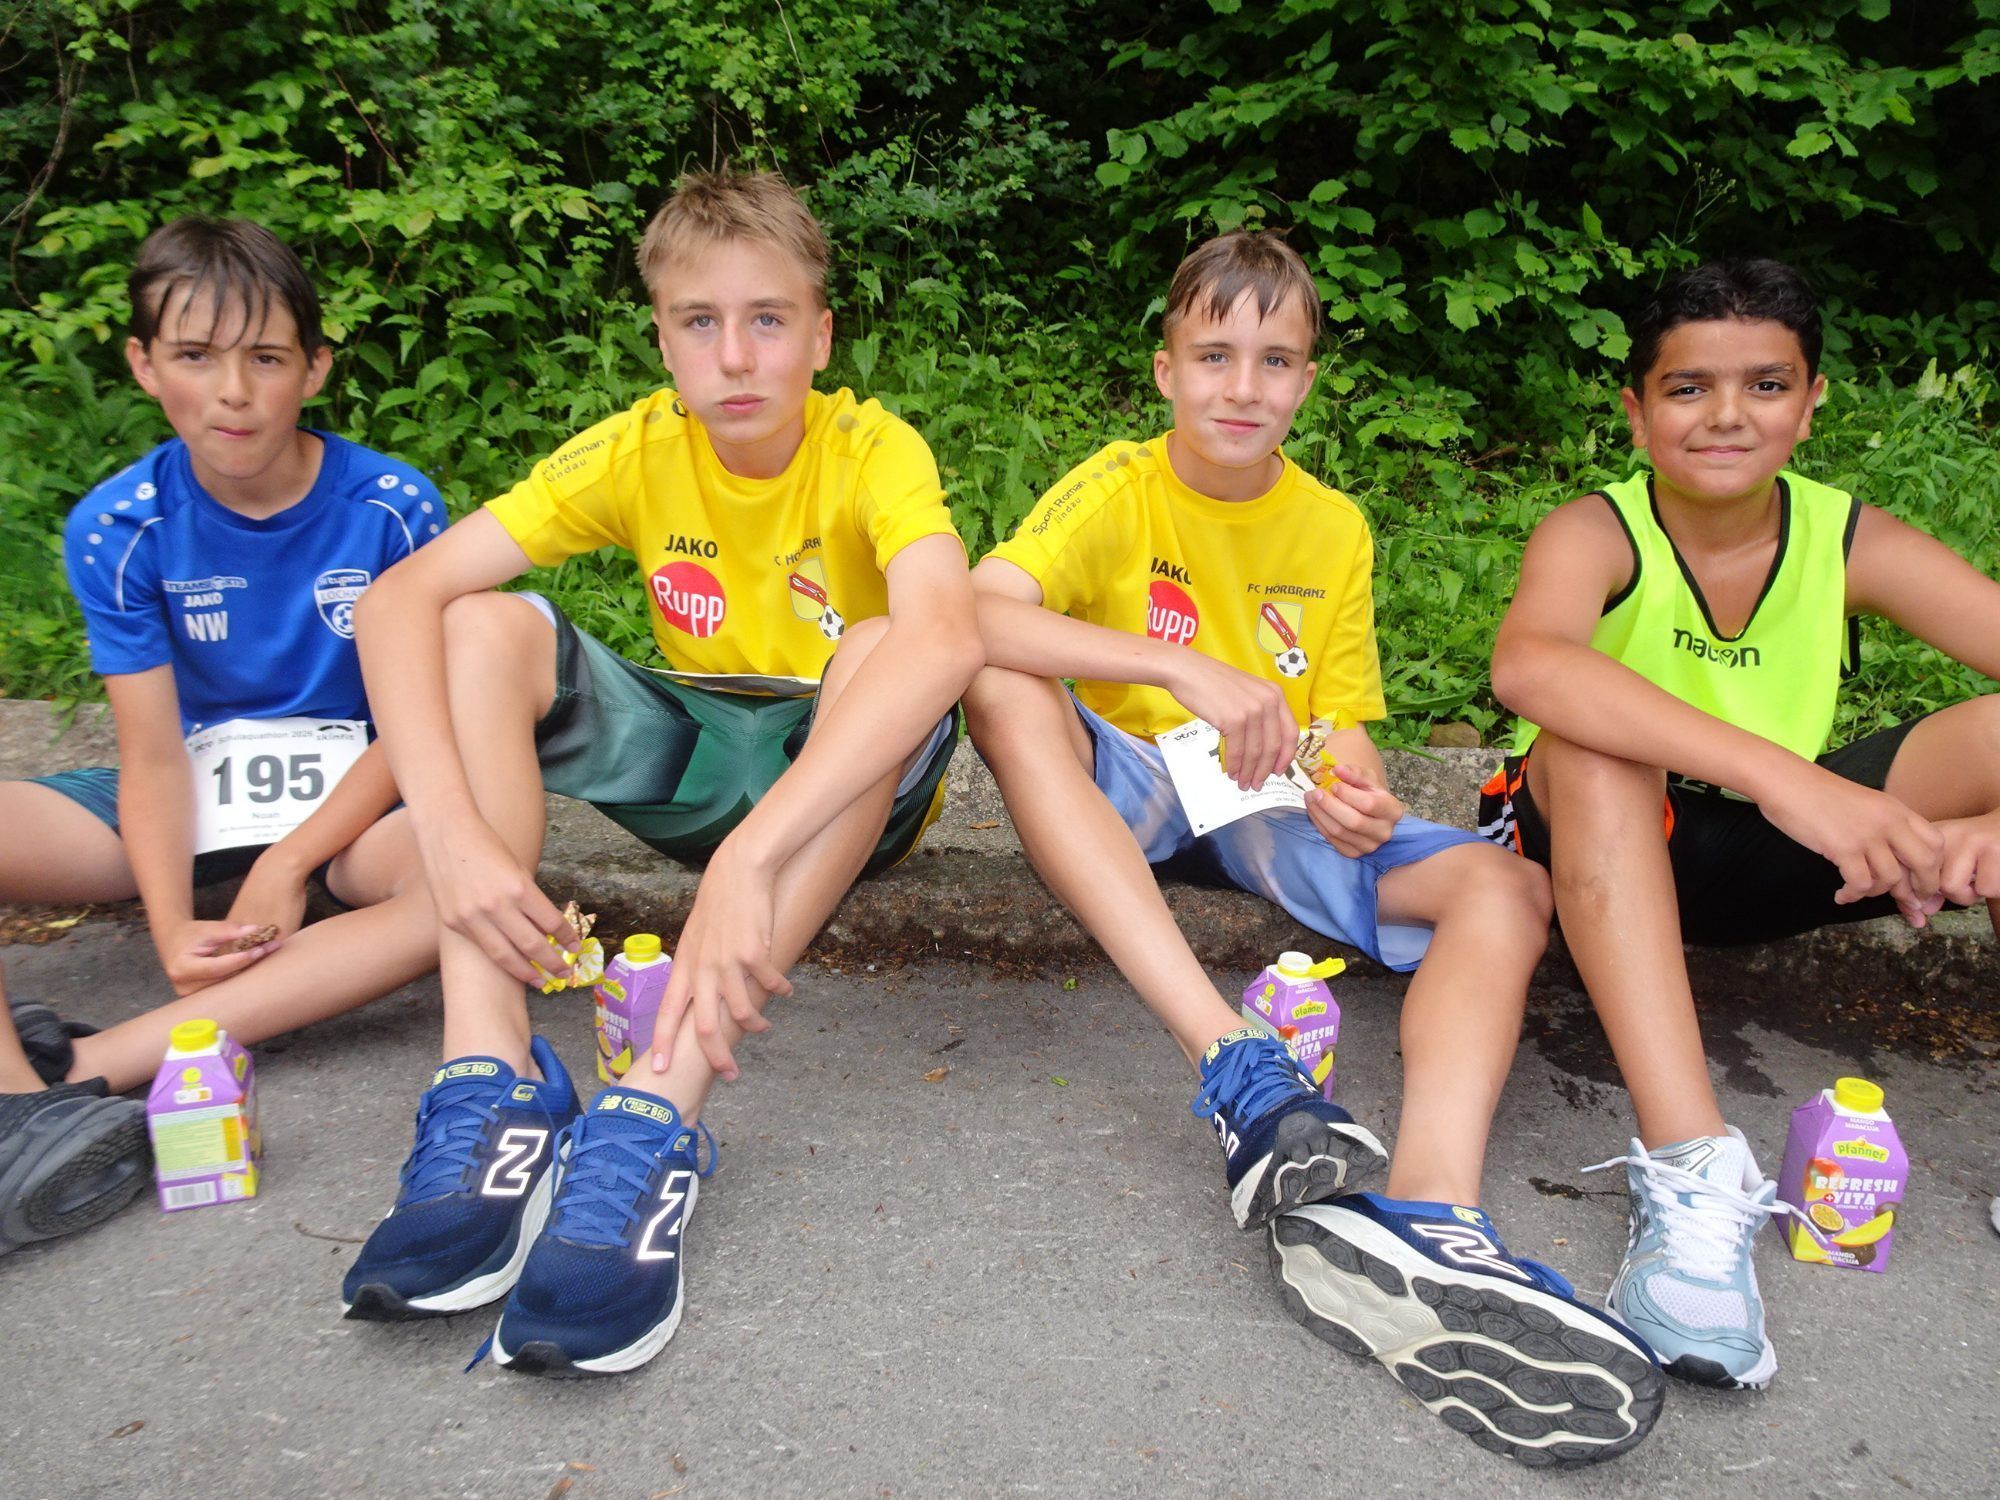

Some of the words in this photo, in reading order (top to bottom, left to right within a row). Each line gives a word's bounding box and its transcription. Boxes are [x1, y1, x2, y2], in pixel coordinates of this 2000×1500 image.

[558, 439, 606, 465] Roman
[1031, 506, 1057, 535] Sport
[1053, 480, 1087, 507] Roman
[664, 533, 719, 558] JAKO
[183, 592, 224, 608] JAKO
[1247, 583, 1261, 594] FC
[1264, 583, 1327, 599] HÖRBRANZ
[652, 575, 725, 638] Rupp
[184, 610, 228, 642] NW
[212, 753, 325, 806] 195
[1285, 1024, 1335, 1048] EFRESH
[470, 1064, 494, 1074] 860
[650, 1106, 669, 1121] 860
[1838, 1142, 1886, 1160] pfanner
[1815, 1175, 1898, 1193] REFRESH
[1833, 1191, 1876, 1206] VITA
[1828, 1249, 1856, 1259] MANGO
